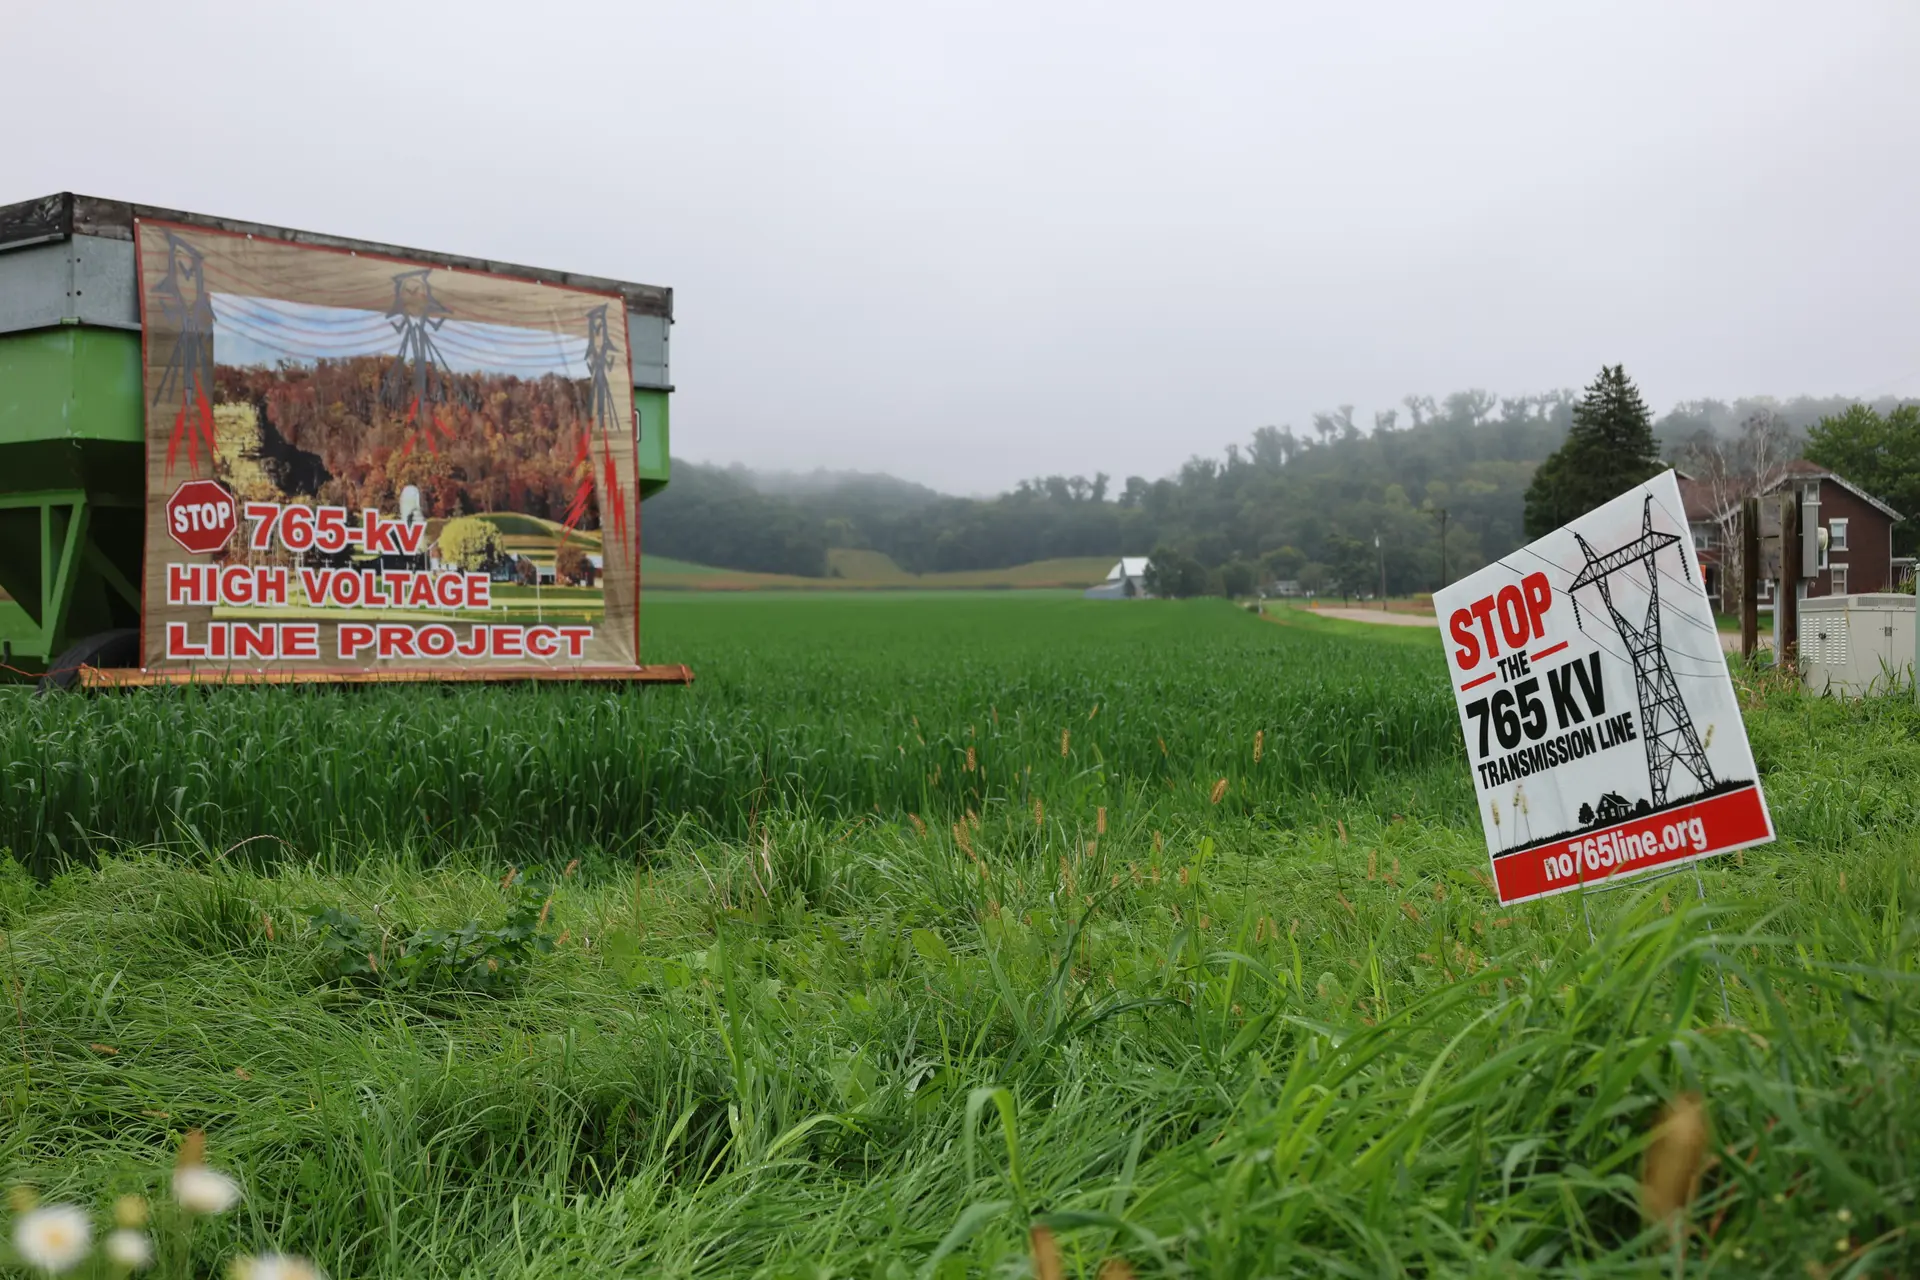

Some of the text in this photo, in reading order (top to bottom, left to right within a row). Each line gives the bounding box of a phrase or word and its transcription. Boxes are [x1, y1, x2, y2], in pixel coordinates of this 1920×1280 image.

[173, 501, 231, 534] STOP
[245, 502, 426, 555] 765-kv
[167, 563, 491, 609] HIGH VOLTAGE
[166, 622, 593, 660] LINE PROJECT
[1449, 571, 1552, 671] STOP
[1497, 650, 1531, 683] THE
[1466, 651, 1607, 759] 765 KV
[1478, 711, 1637, 790] TRANSMISSION LINE
[1543, 817, 1707, 881] no765line.org
